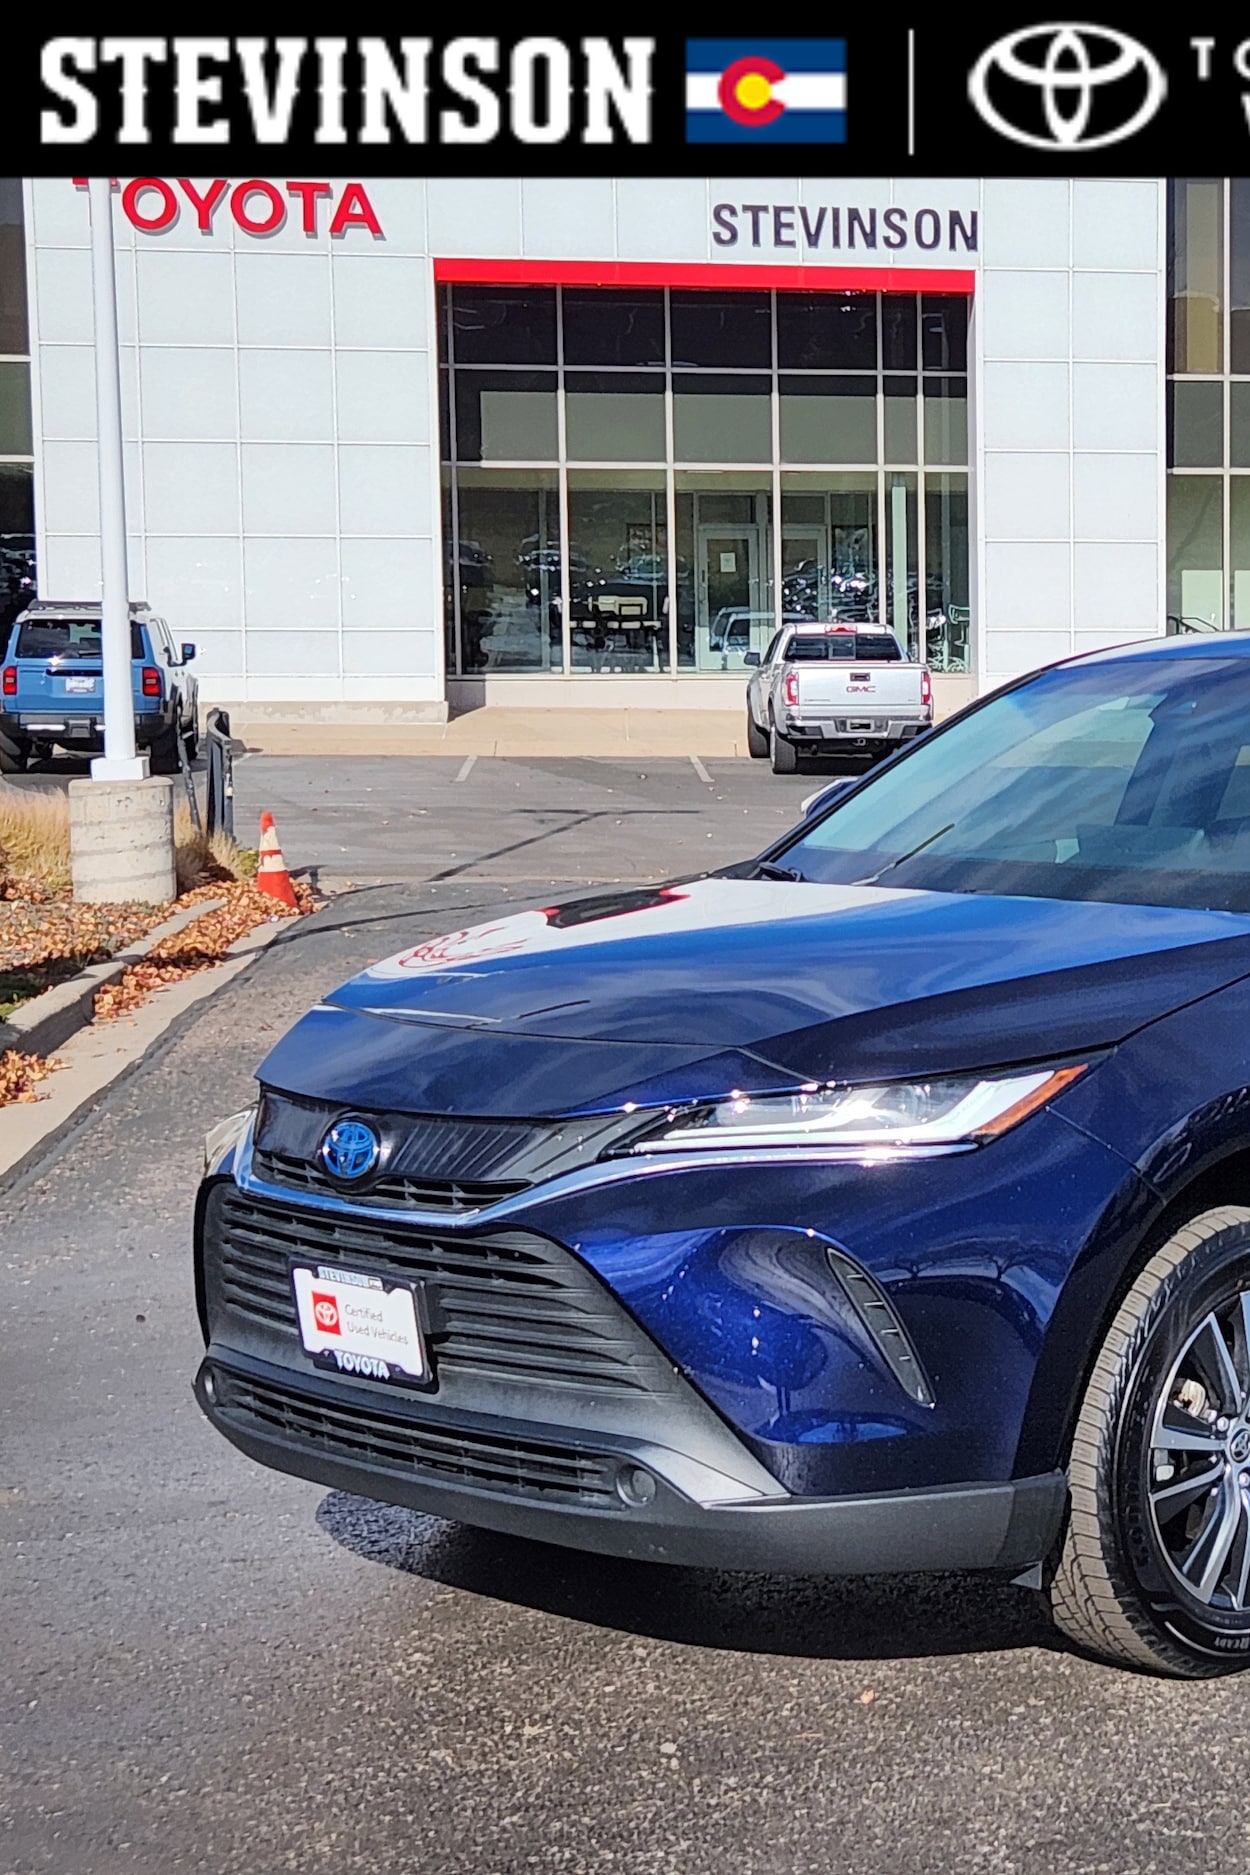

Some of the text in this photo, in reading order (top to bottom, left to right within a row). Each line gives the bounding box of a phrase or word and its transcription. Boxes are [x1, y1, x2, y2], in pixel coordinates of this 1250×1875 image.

[73, 177, 384, 235] OYOTA
[712, 203, 978, 252] STEVINSON
[846, 685, 876, 693] GMC
[345, 1304, 383, 1322] Certified
[347, 1321, 408, 1345] Used Vehicles
[334, 1350, 390, 1380] TOYOTA
